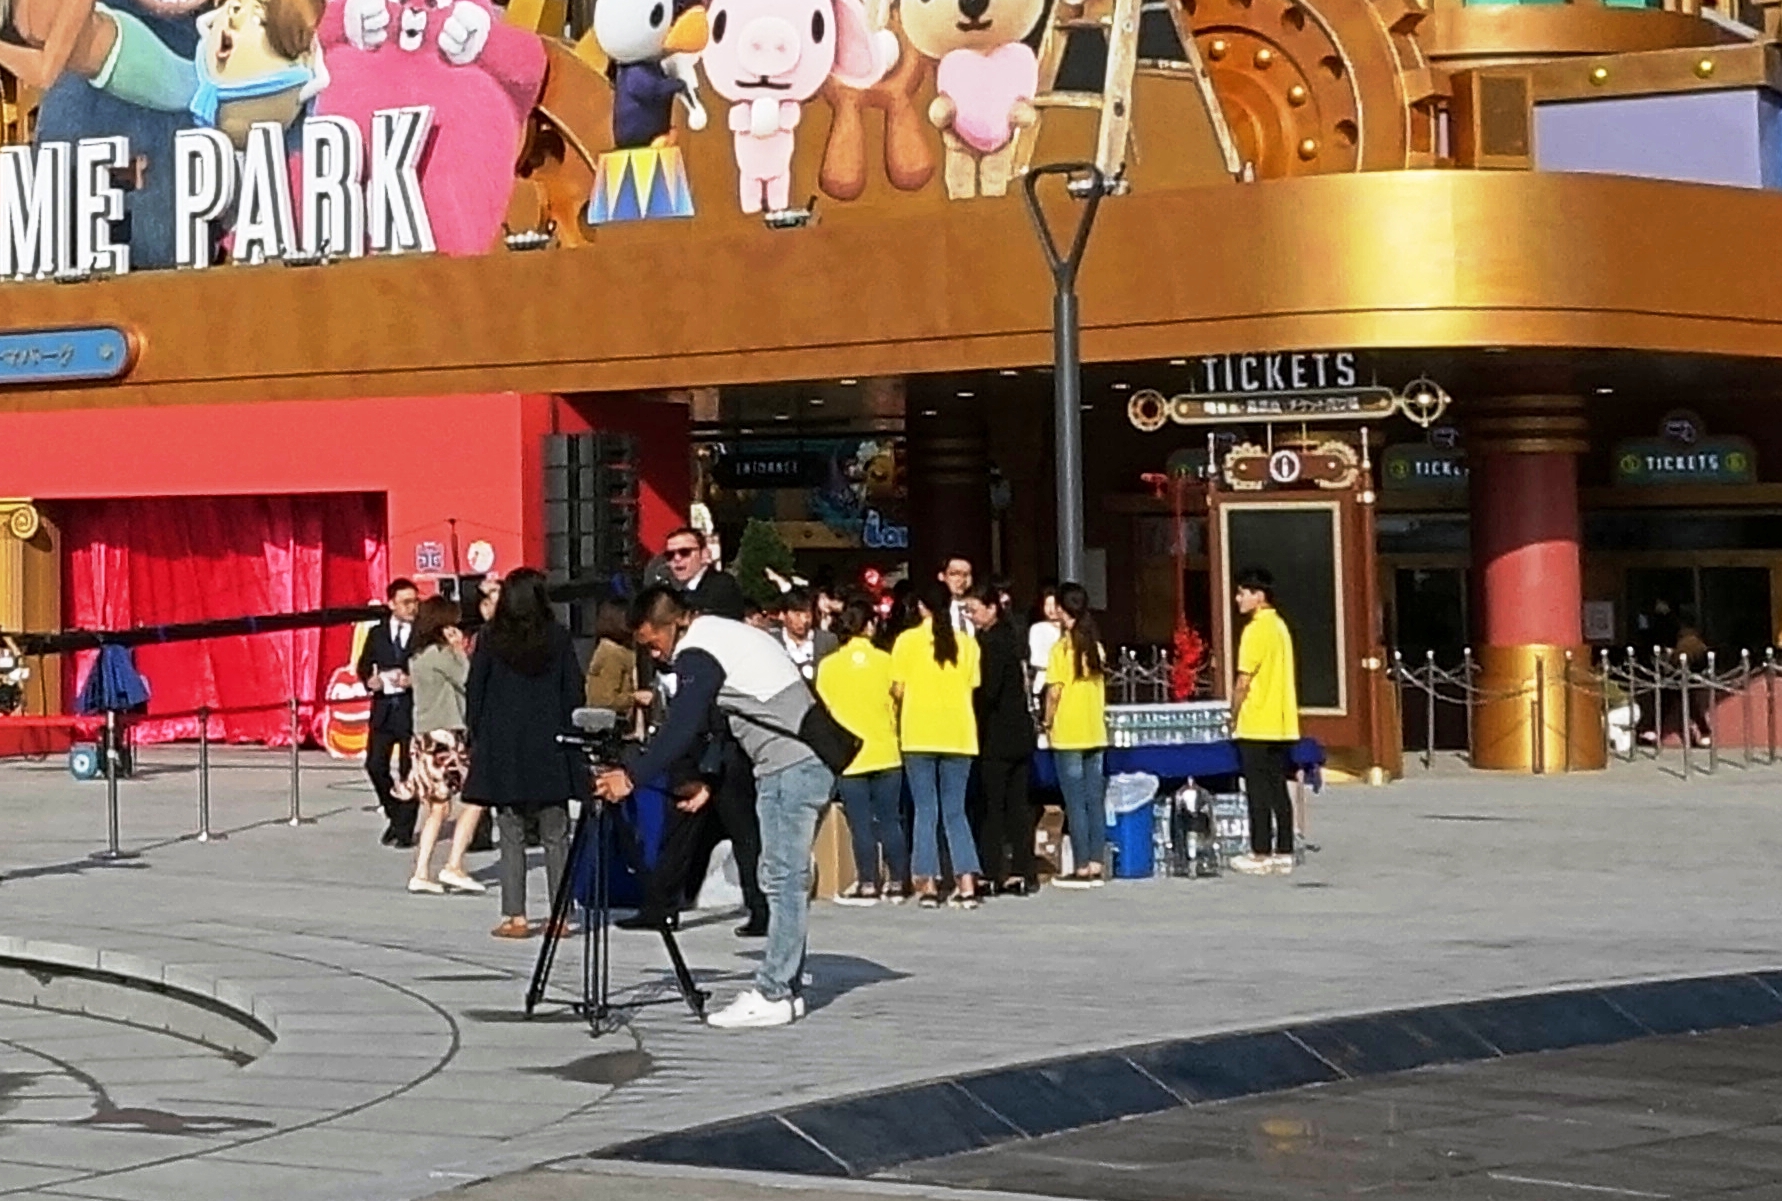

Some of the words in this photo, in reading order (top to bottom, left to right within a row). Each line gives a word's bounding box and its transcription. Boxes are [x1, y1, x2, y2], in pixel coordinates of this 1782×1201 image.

[174, 104, 438, 270] PARK
[1201, 351, 1356, 392] TICKETS
[1645, 453, 1719, 472] TICKETS
